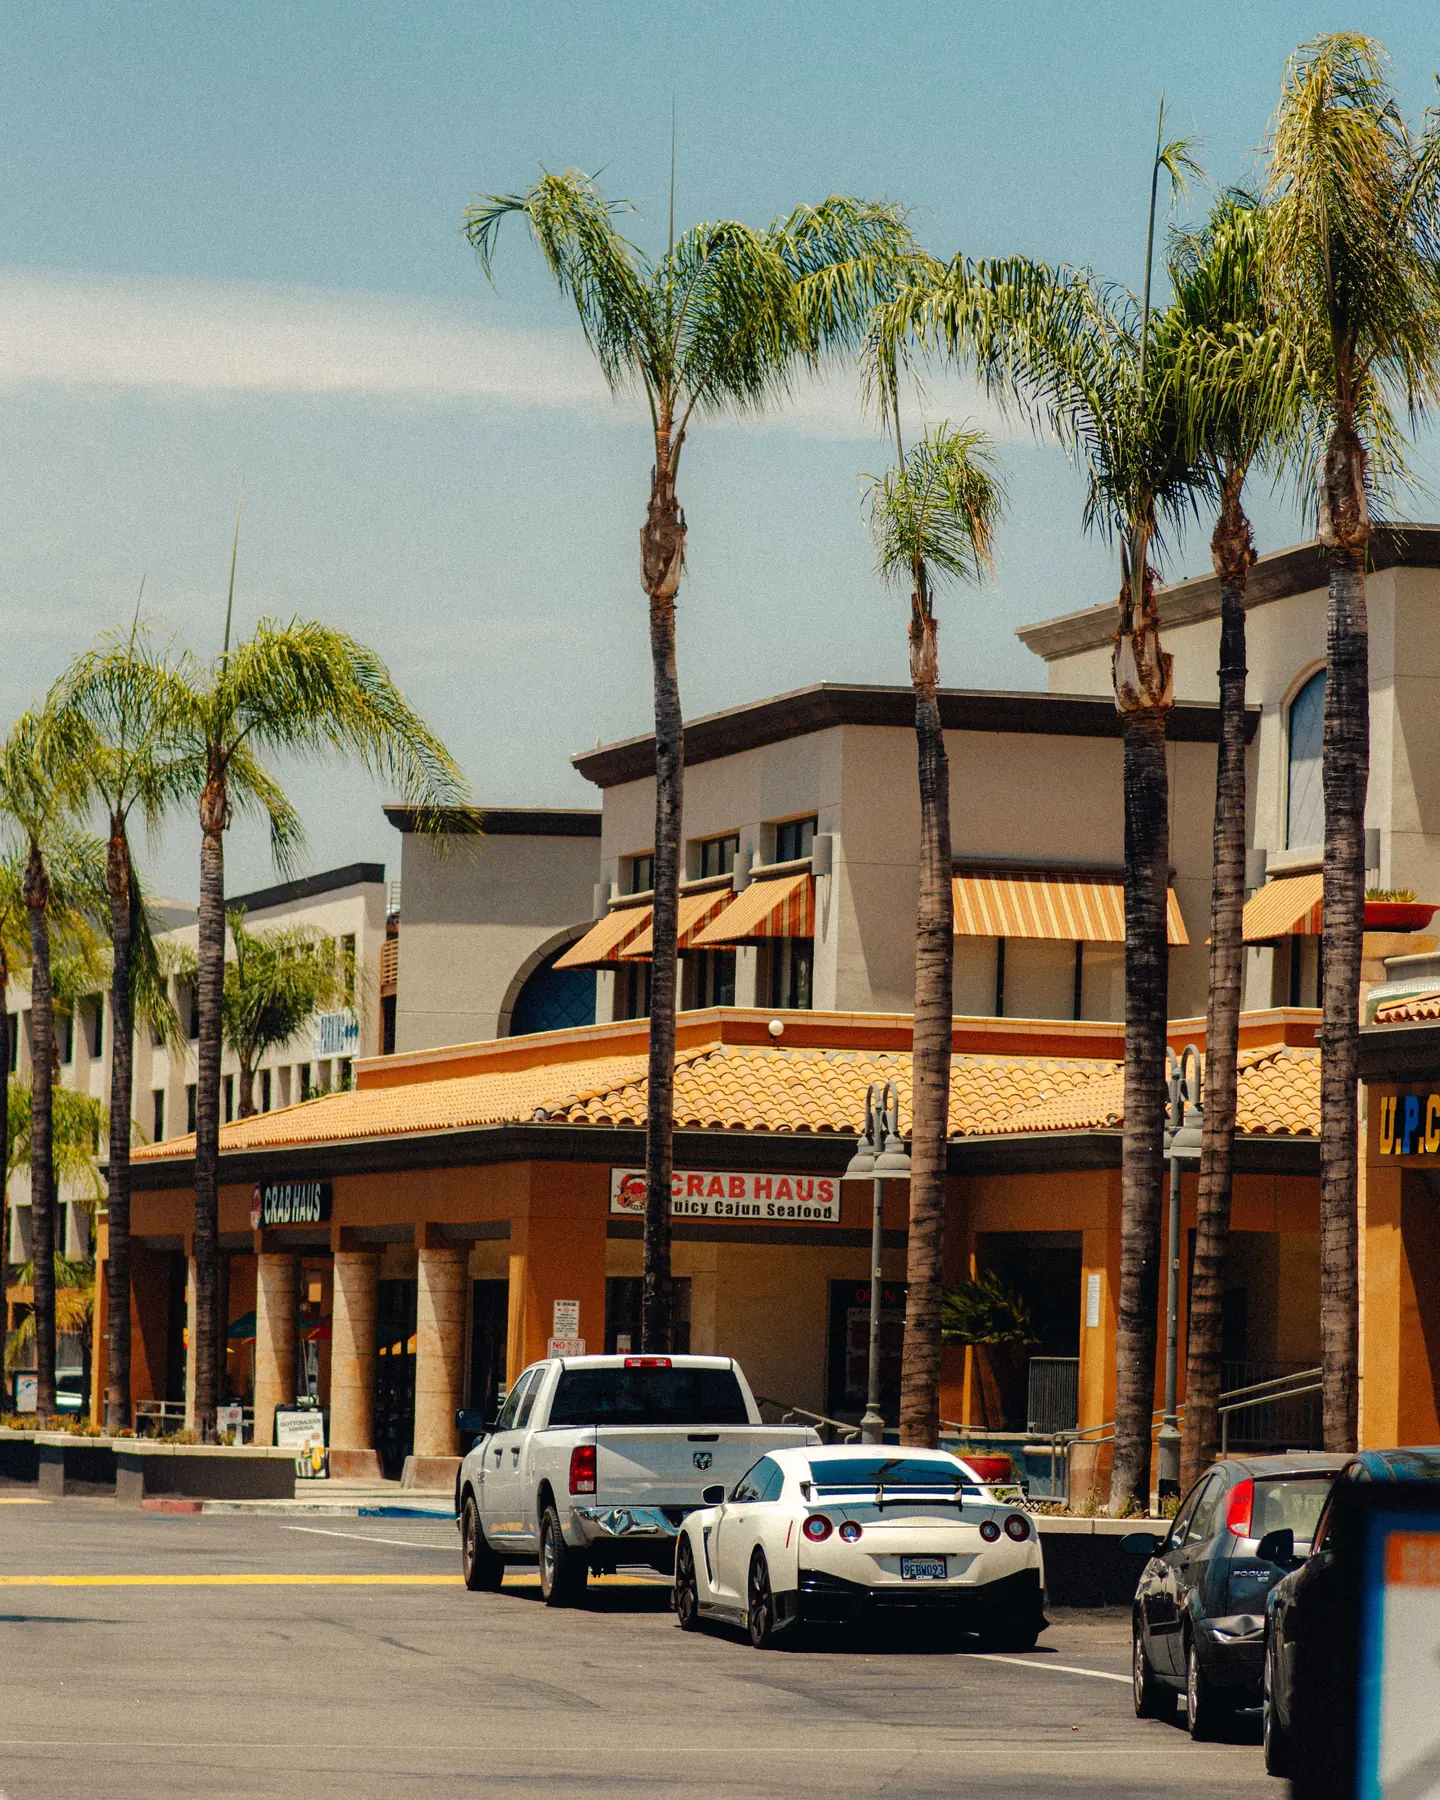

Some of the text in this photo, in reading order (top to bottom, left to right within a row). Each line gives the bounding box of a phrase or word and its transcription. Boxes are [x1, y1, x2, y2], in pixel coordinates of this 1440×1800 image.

[671, 1173, 834, 1203] CRAB HAUS
[264, 1183, 321, 1224] CRAB HAUS
[674, 1200, 832, 1219] uicy Cajun Seafood
[552, 1341, 566, 1349] NO
